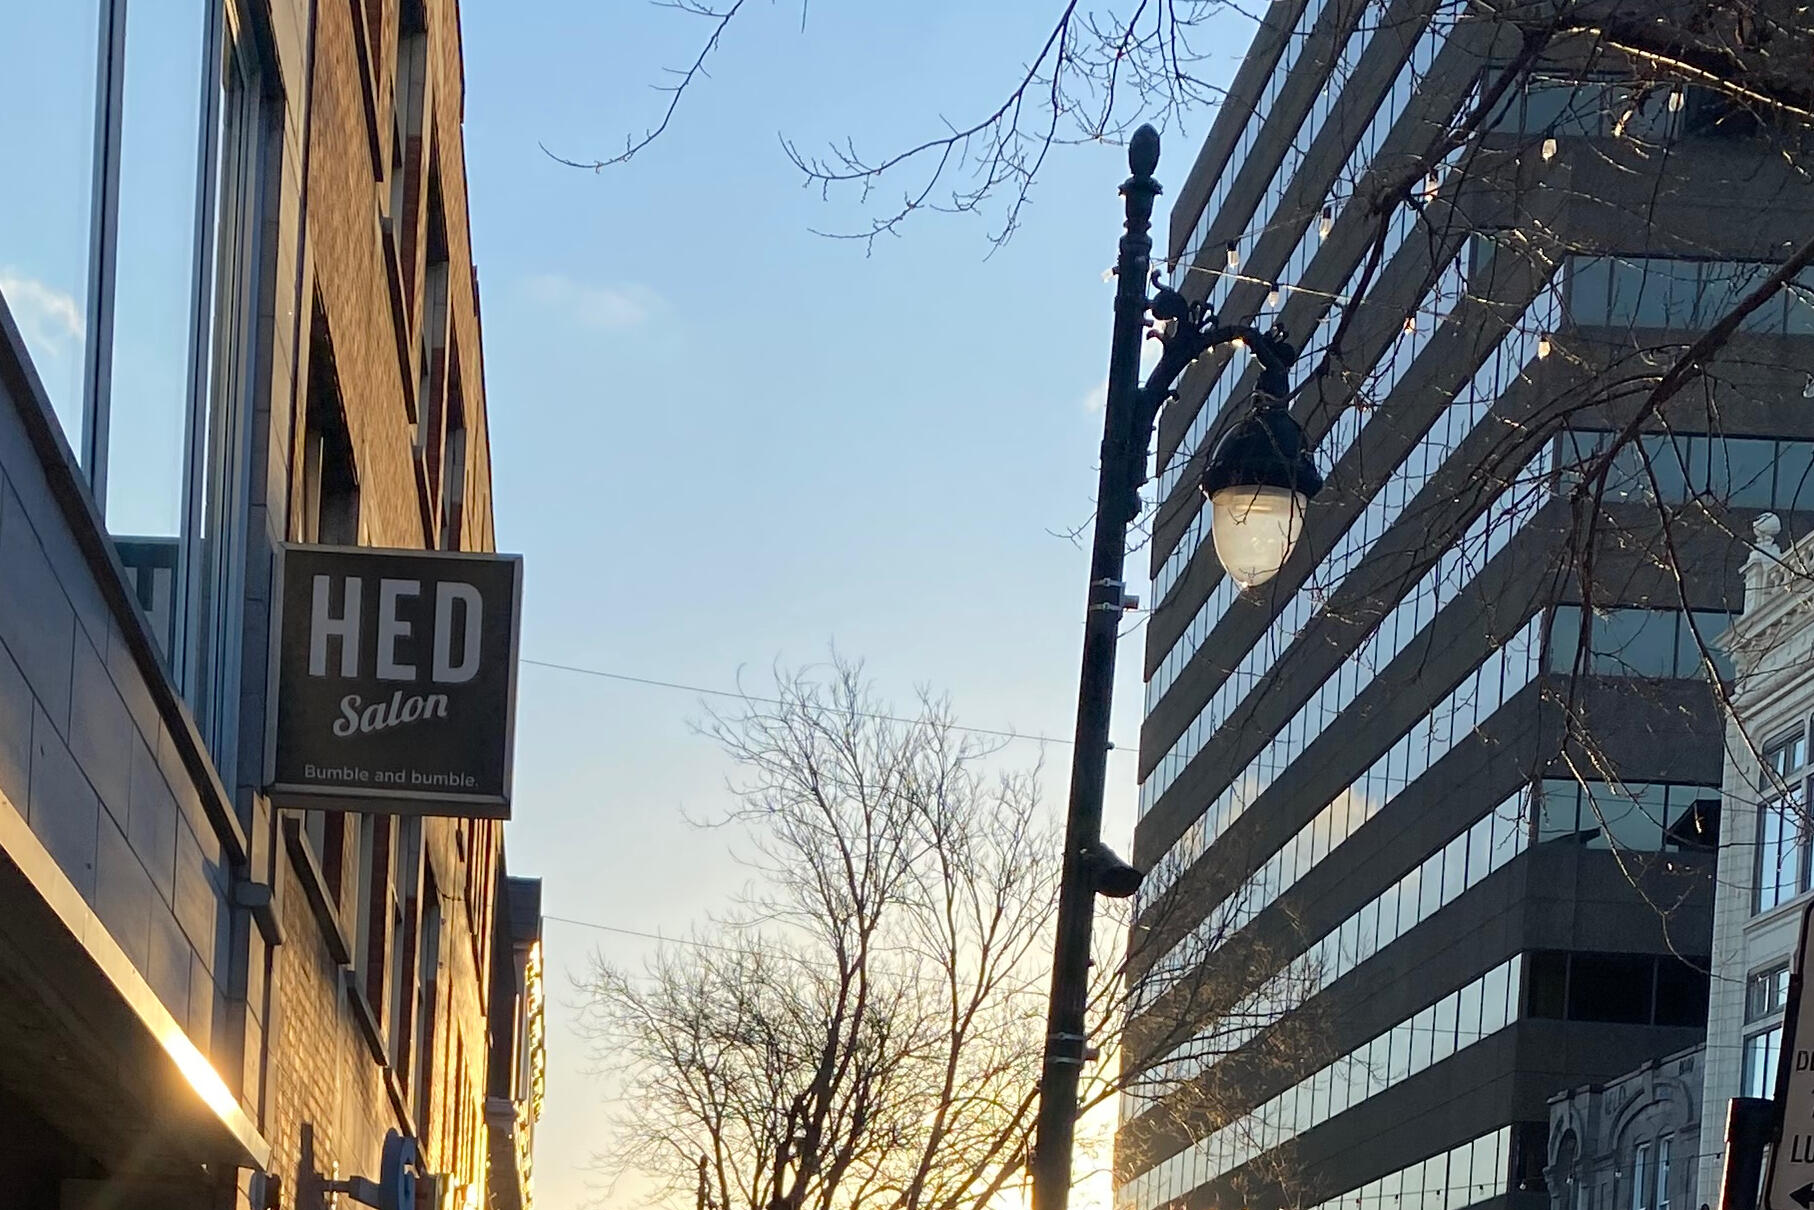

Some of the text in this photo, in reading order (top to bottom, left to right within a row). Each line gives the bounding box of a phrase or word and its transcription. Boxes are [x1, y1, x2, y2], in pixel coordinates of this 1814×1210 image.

[309, 574, 483, 683] HED
[332, 690, 449, 737] Salon
[304, 764, 369, 781] Bumble
[374, 767, 406, 784] and
